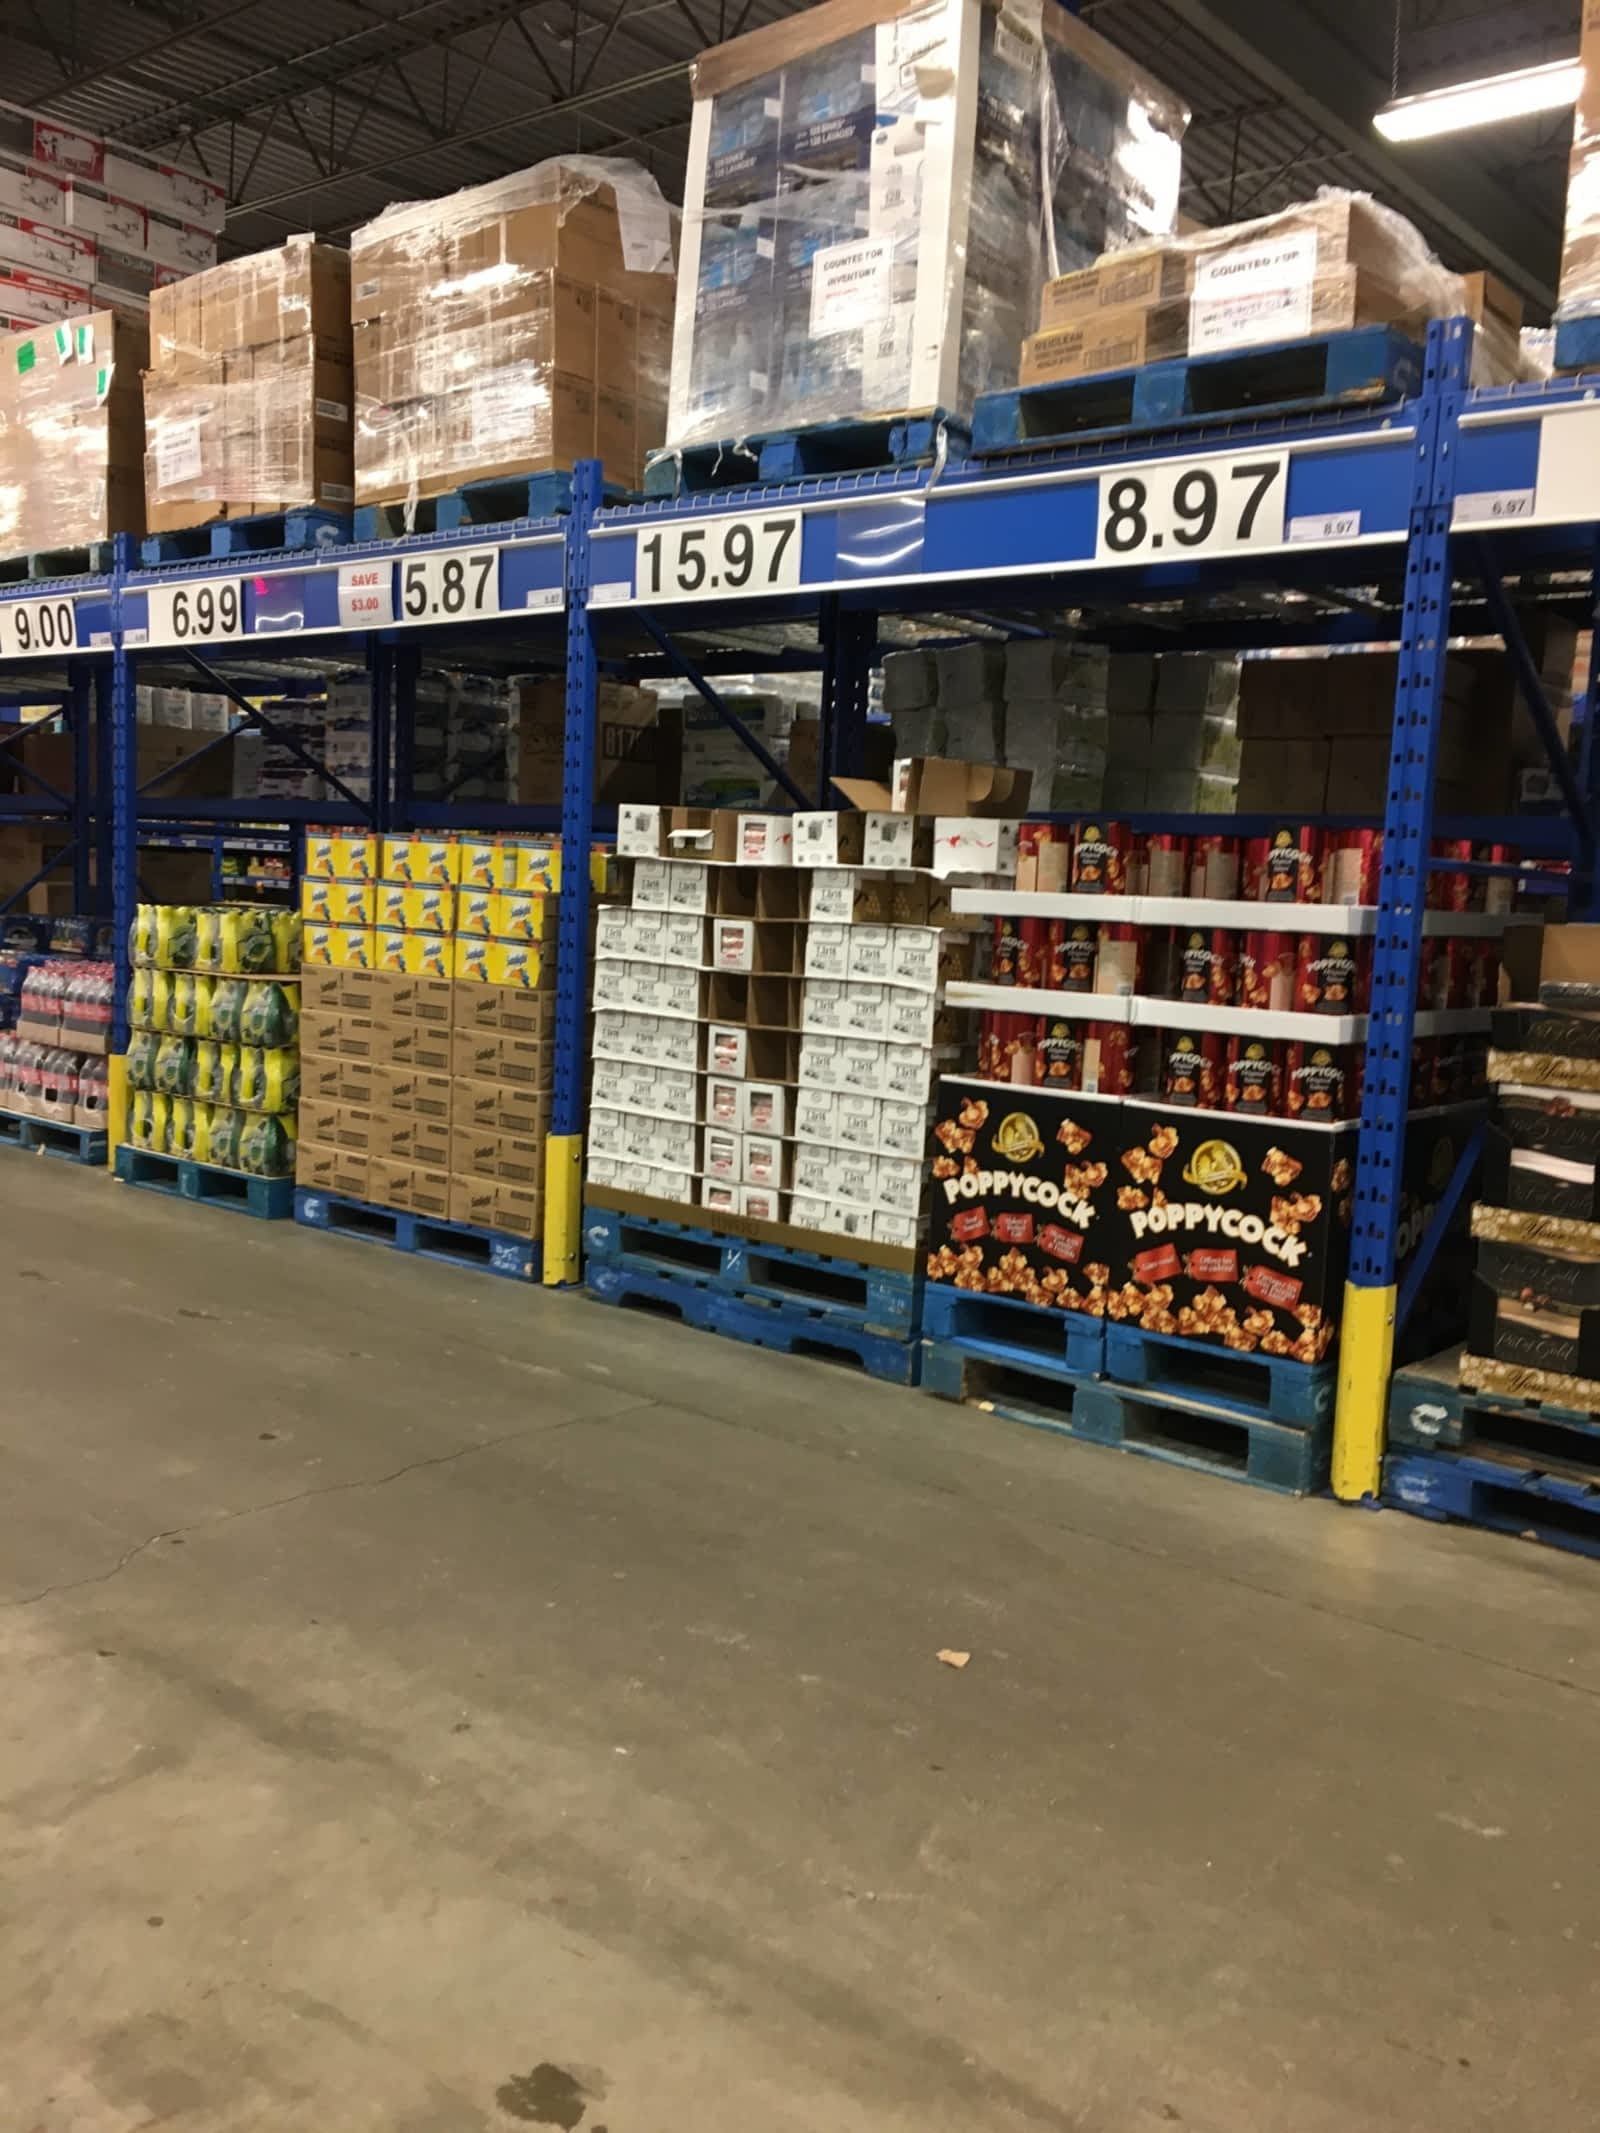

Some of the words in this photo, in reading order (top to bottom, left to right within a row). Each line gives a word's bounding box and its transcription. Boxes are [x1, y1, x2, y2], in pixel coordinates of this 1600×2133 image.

[1210, 256, 1271, 279] COUNTED
[1104, 460, 1281, 553] 8.97
[1323, 519, 1354, 536] 8.97
[351, 572, 379, 586] SAVE
[642, 518, 796, 593] 15.97
[172, 584, 238, 638] 6.99
[351, 597, 379, 612] $3.00
[404, 554, 495, 617] 5.87
[14, 603, 74, 650] 9.00
[943, 1169, 1096, 1230] POPPYCOCK
[1129, 1203, 1308, 1268] POPPYCOCK
